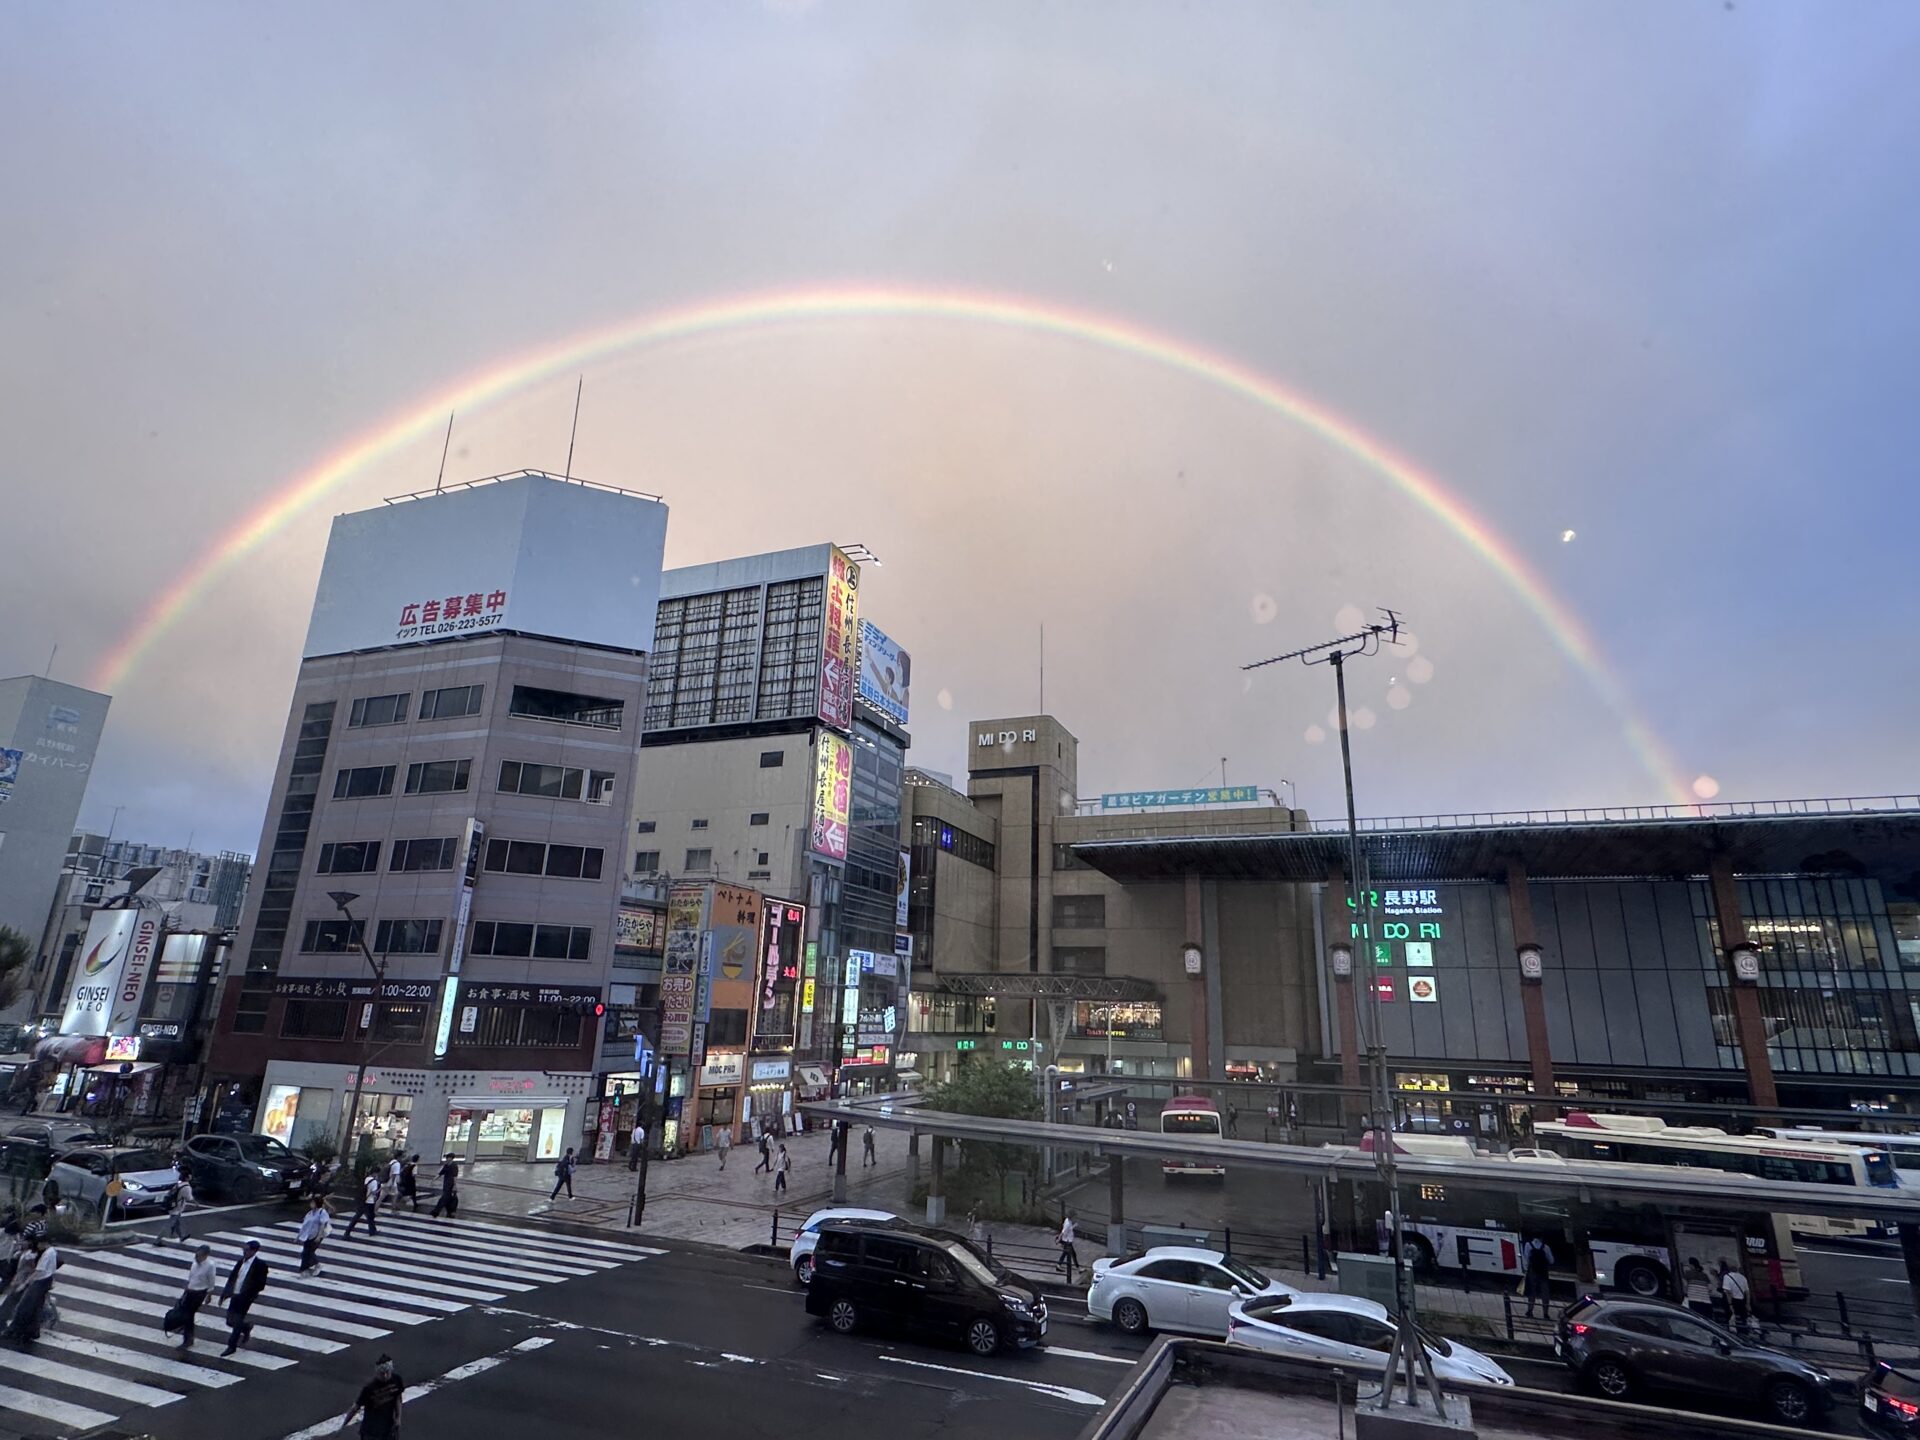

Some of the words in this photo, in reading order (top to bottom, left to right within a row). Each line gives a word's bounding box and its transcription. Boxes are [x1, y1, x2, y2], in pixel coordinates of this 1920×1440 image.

[399, 589, 506, 627] 広告募集中
[420, 625, 436, 636] TEL
[1384, 889, 1437, 906] 長野駅
[1385, 907, 1413, 915] Nagano
[1415, 906, 1443, 914] Station
[616, 916, 653, 931] おたからや
[122, 920, 155, 1003] GINSEI-NEO
[662, 976, 693, 993] お売り
[76, 986, 110, 1001] GINSEI
[76, 1001, 103, 1011] NEO
[140, 1023, 178, 1036] GINSEI-NEO
